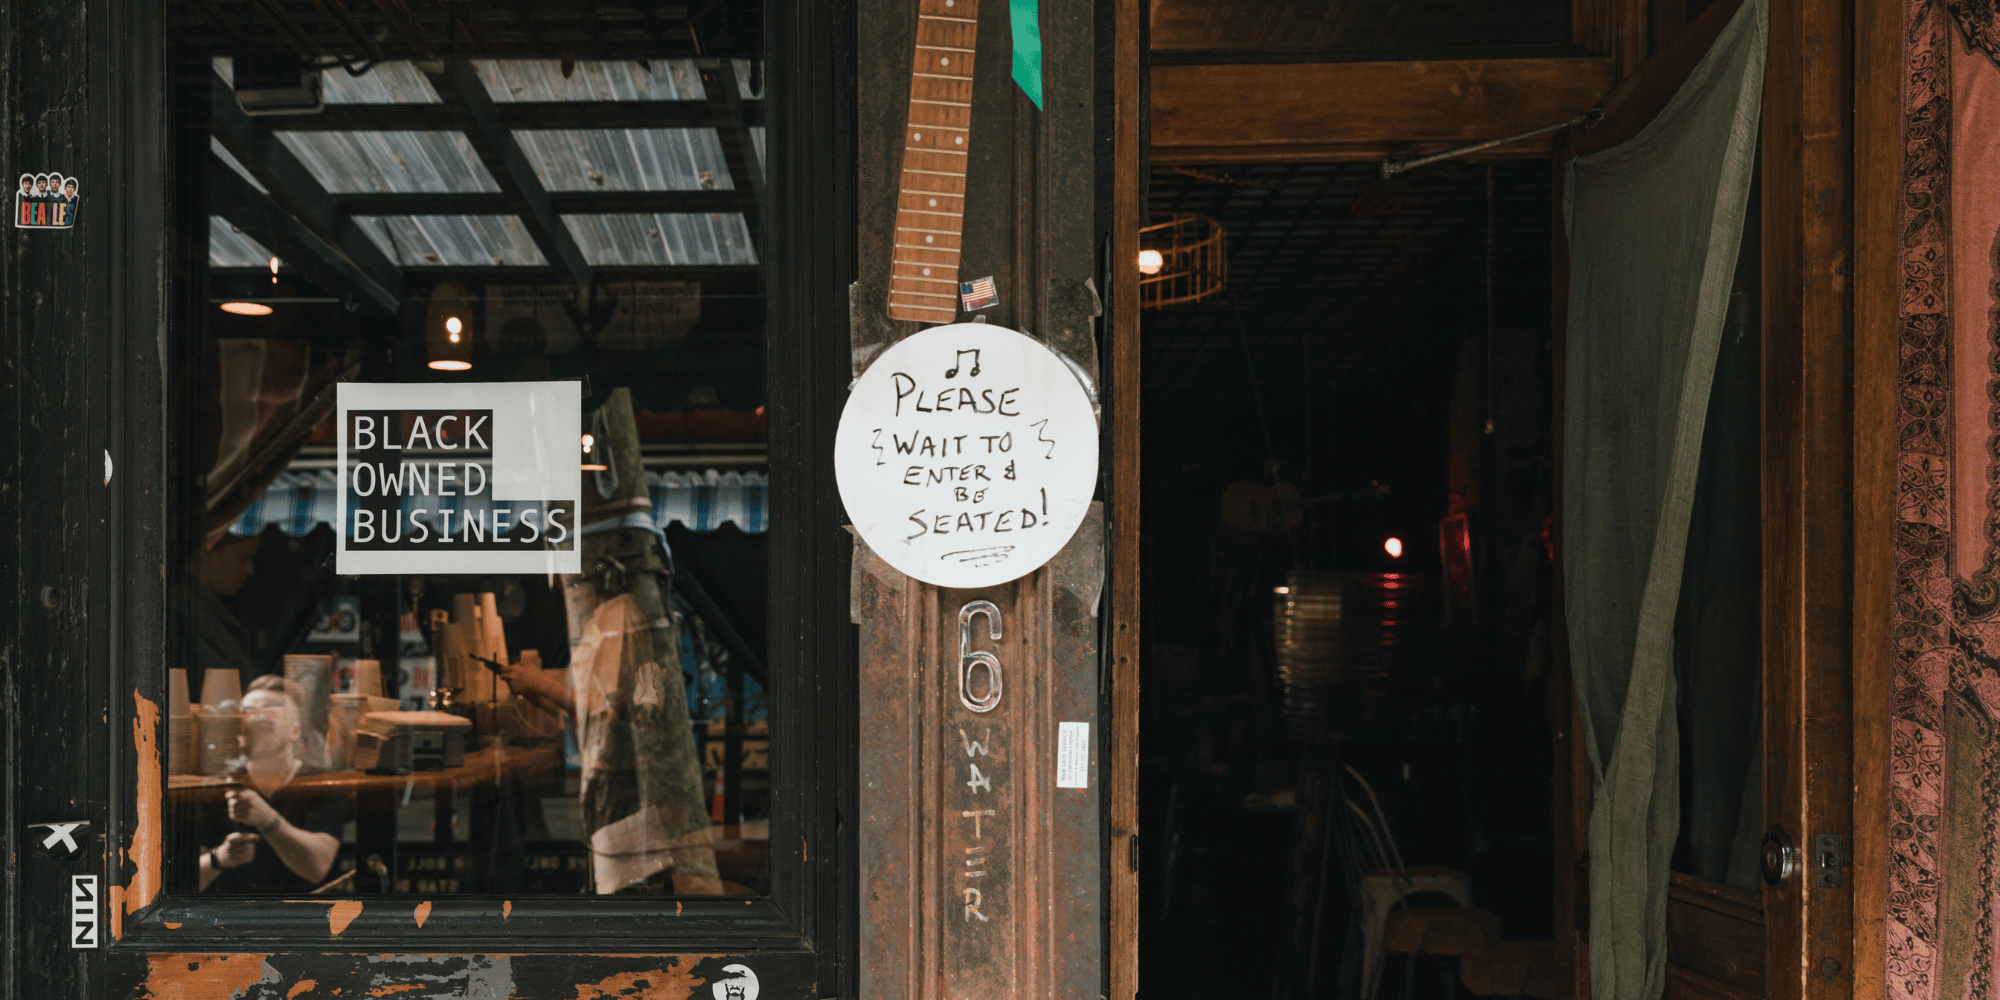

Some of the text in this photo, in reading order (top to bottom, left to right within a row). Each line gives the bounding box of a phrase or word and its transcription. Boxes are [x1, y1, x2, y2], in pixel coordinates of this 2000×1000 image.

[21, 201, 75, 226] BEATLES
[890, 371, 1021, 418] PLEASE
[354, 415, 489, 450] BLACK
[892, 429, 1013, 458] WAIT TO
[352, 462, 486, 497] OWNED
[903, 463, 992, 488] ENTER
[954, 486, 990, 504] BE
[353, 508, 568, 544] BUSINESS
[906, 486, 1050, 540] SEATED!
[958, 600, 1003, 712] 6
[959, 728, 996, 922] WATER
